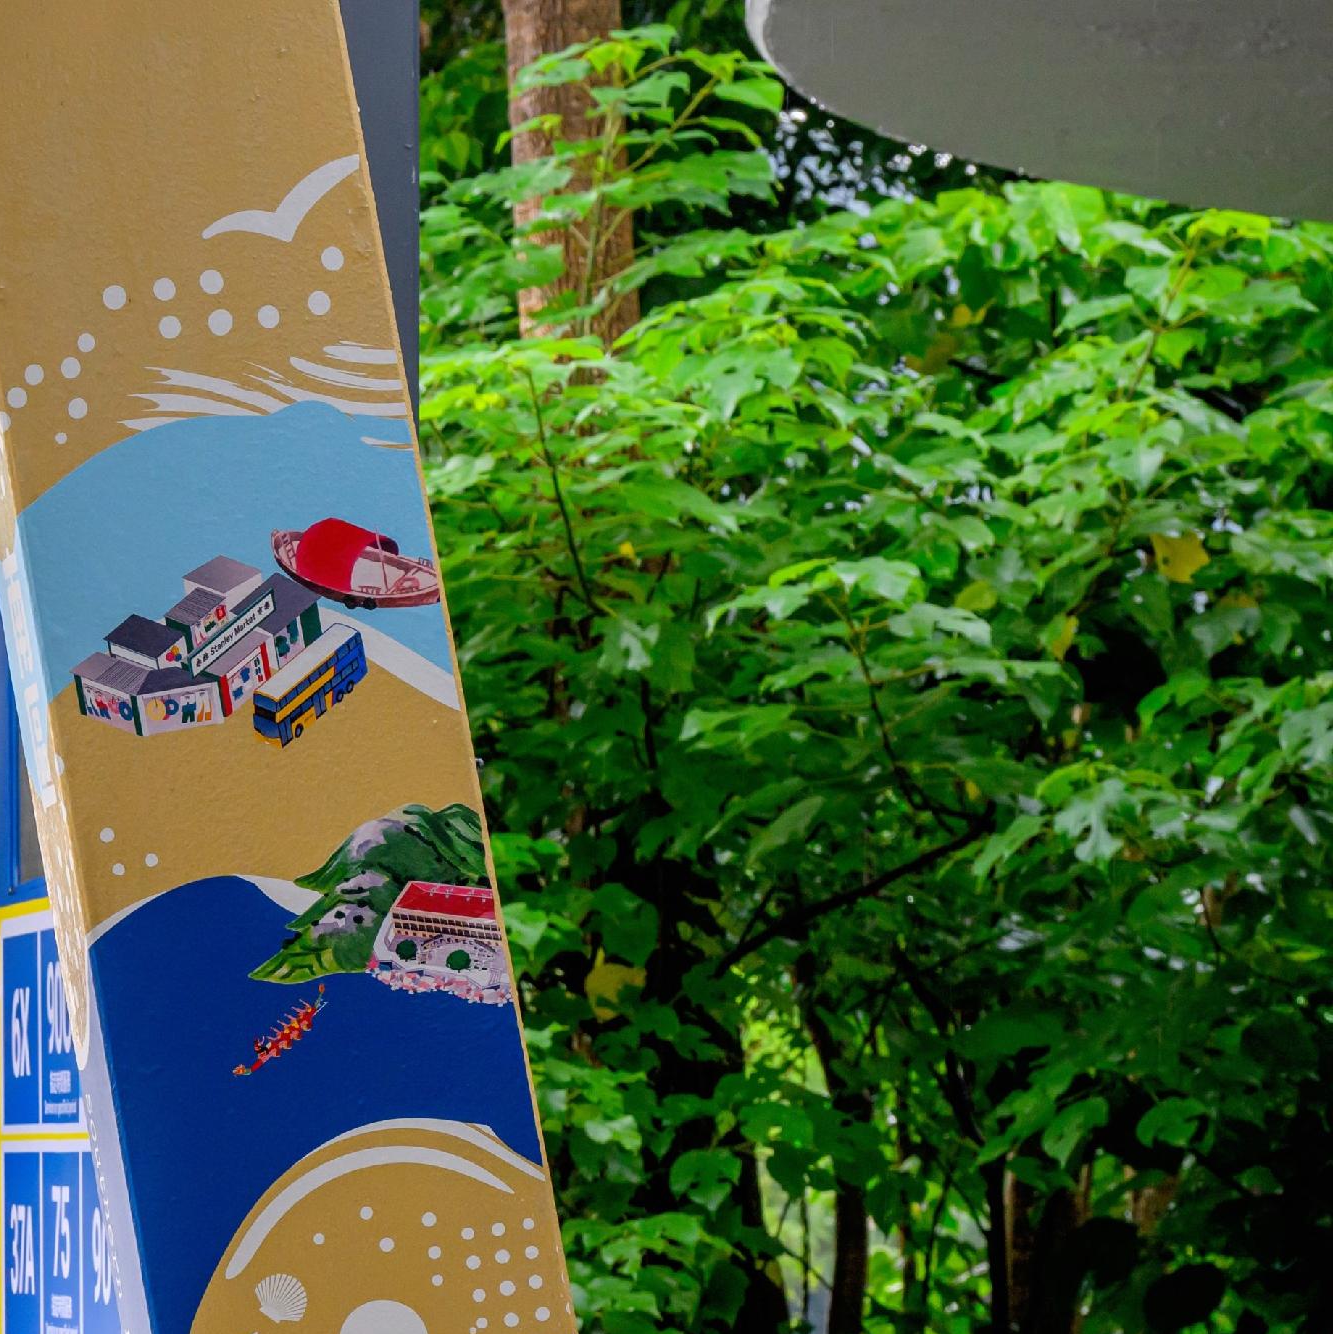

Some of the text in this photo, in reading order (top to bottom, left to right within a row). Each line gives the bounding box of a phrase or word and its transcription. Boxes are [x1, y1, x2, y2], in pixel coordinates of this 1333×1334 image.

[10, 987, 31, 1078] 6X
[10, 1204, 35, 1295] 37A
[51, 1185, 70, 1280] 75
